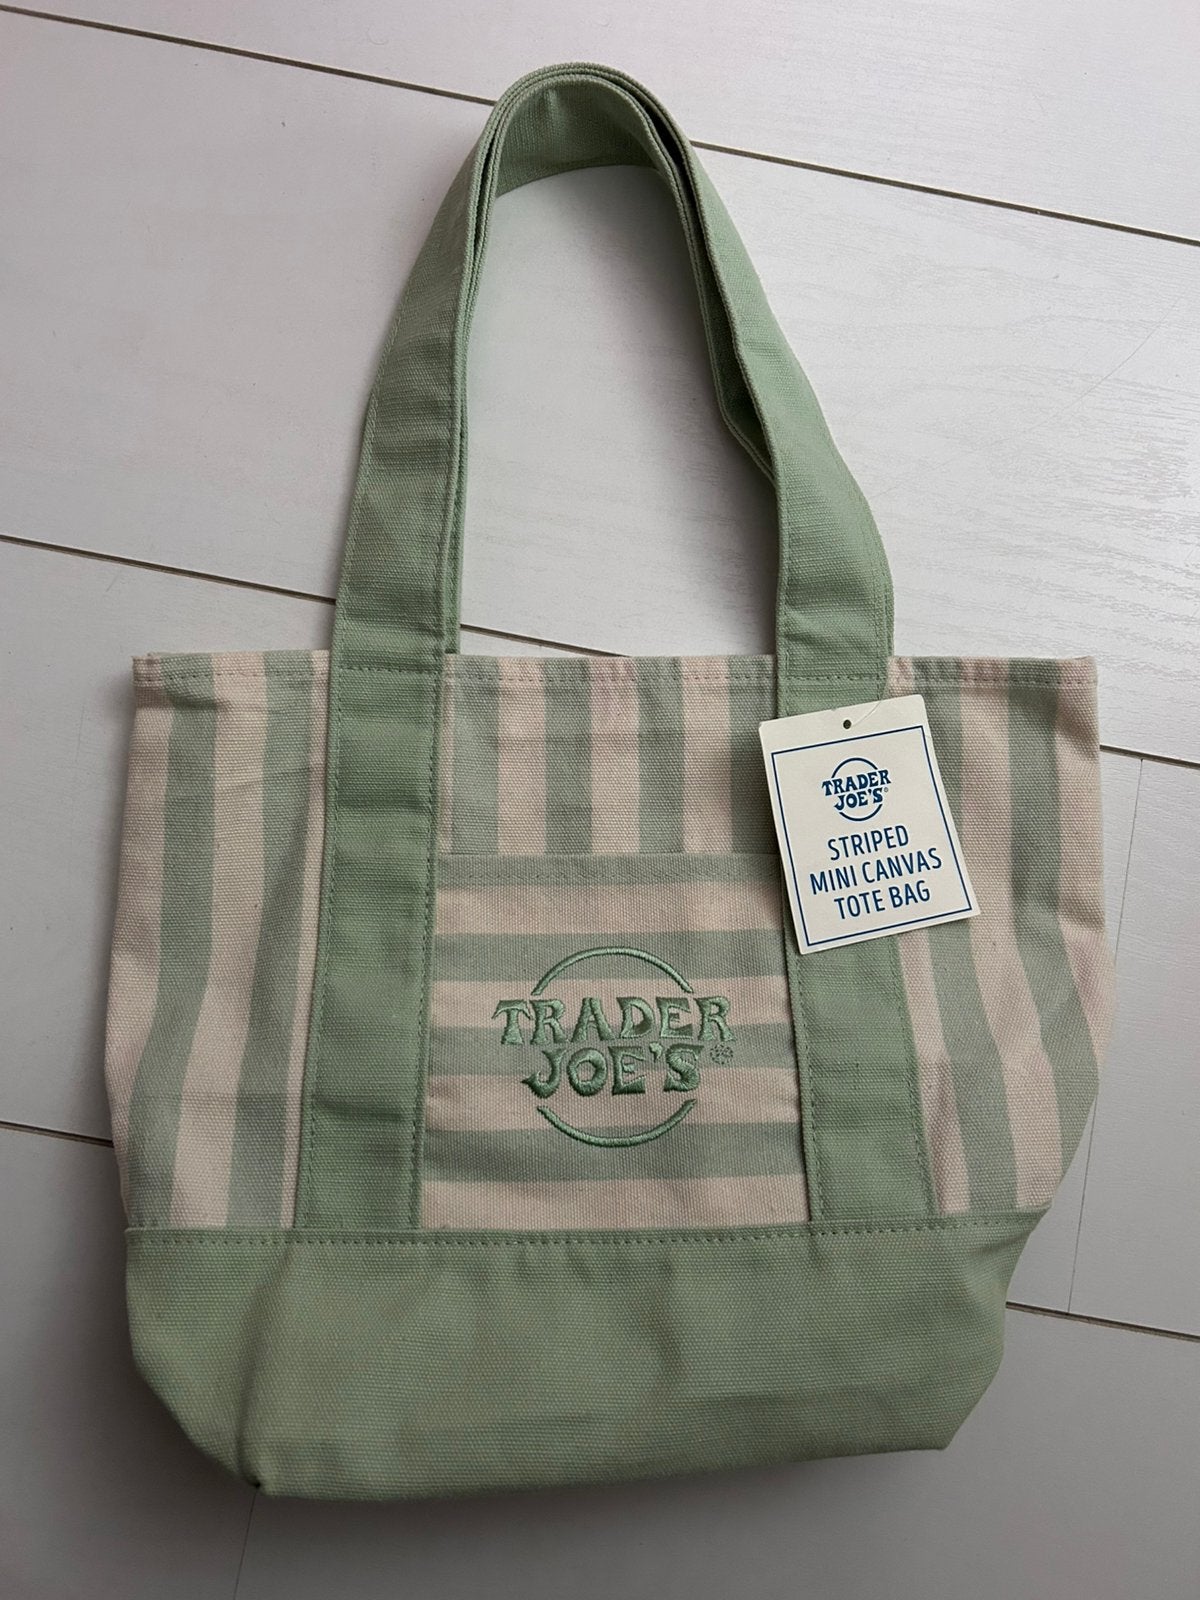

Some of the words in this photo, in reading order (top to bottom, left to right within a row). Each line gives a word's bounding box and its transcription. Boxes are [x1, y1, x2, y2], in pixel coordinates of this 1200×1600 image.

[821, 769, 892, 796] TRADER
[834, 787, 883, 811] JOE'S
[827, 825, 909, 861] STRIPED
[809, 865, 858, 895] MINI
[861, 847, 942, 884] CANVAS
[834, 889, 886, 920] TOTE
[889, 880, 931, 909] BAG
[491, 995, 737, 1045] TRADER
[520, 1041, 705, 1099] JOE'S
